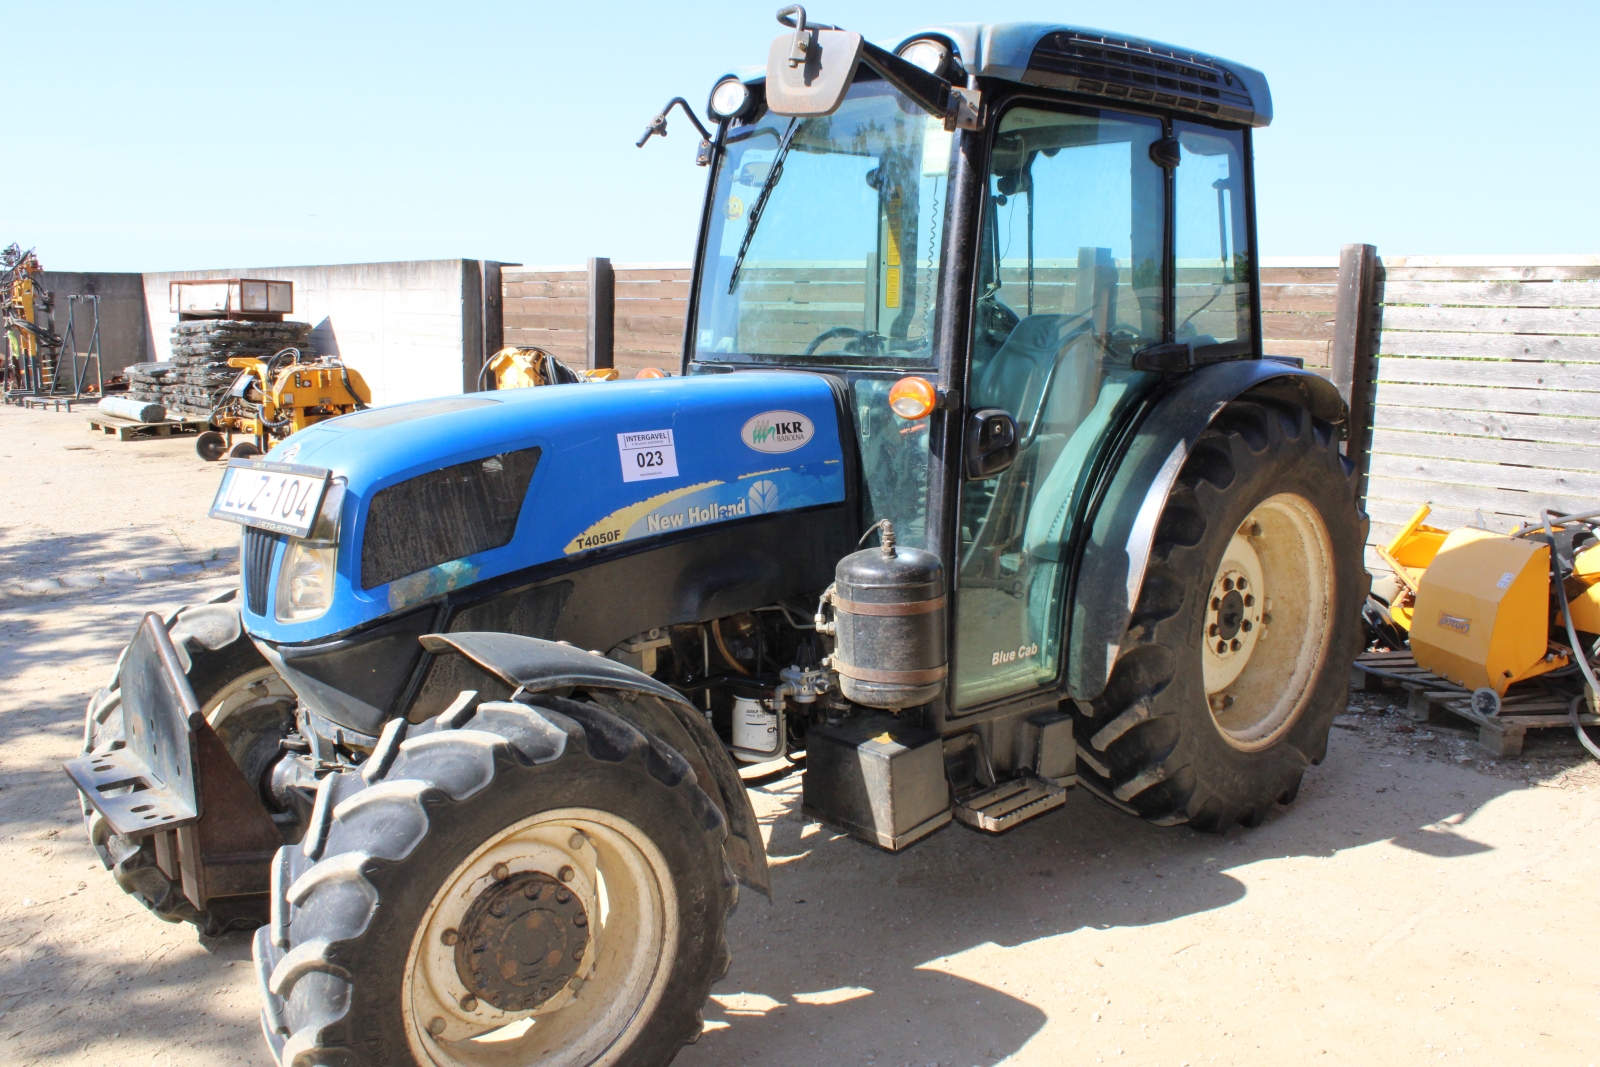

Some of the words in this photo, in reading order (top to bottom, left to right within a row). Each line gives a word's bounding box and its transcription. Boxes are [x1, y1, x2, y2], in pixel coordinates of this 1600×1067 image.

[775, 421, 804, 435] IKR
[625, 432, 668, 443] INTERGAVEL
[636, 450, 664, 468] 023
[647, 513, 684, 532] New
[576, 529, 621, 550] T4050F
[991, 650, 1016, 666] Blue
[1017, 642, 1038, 659] Cab
